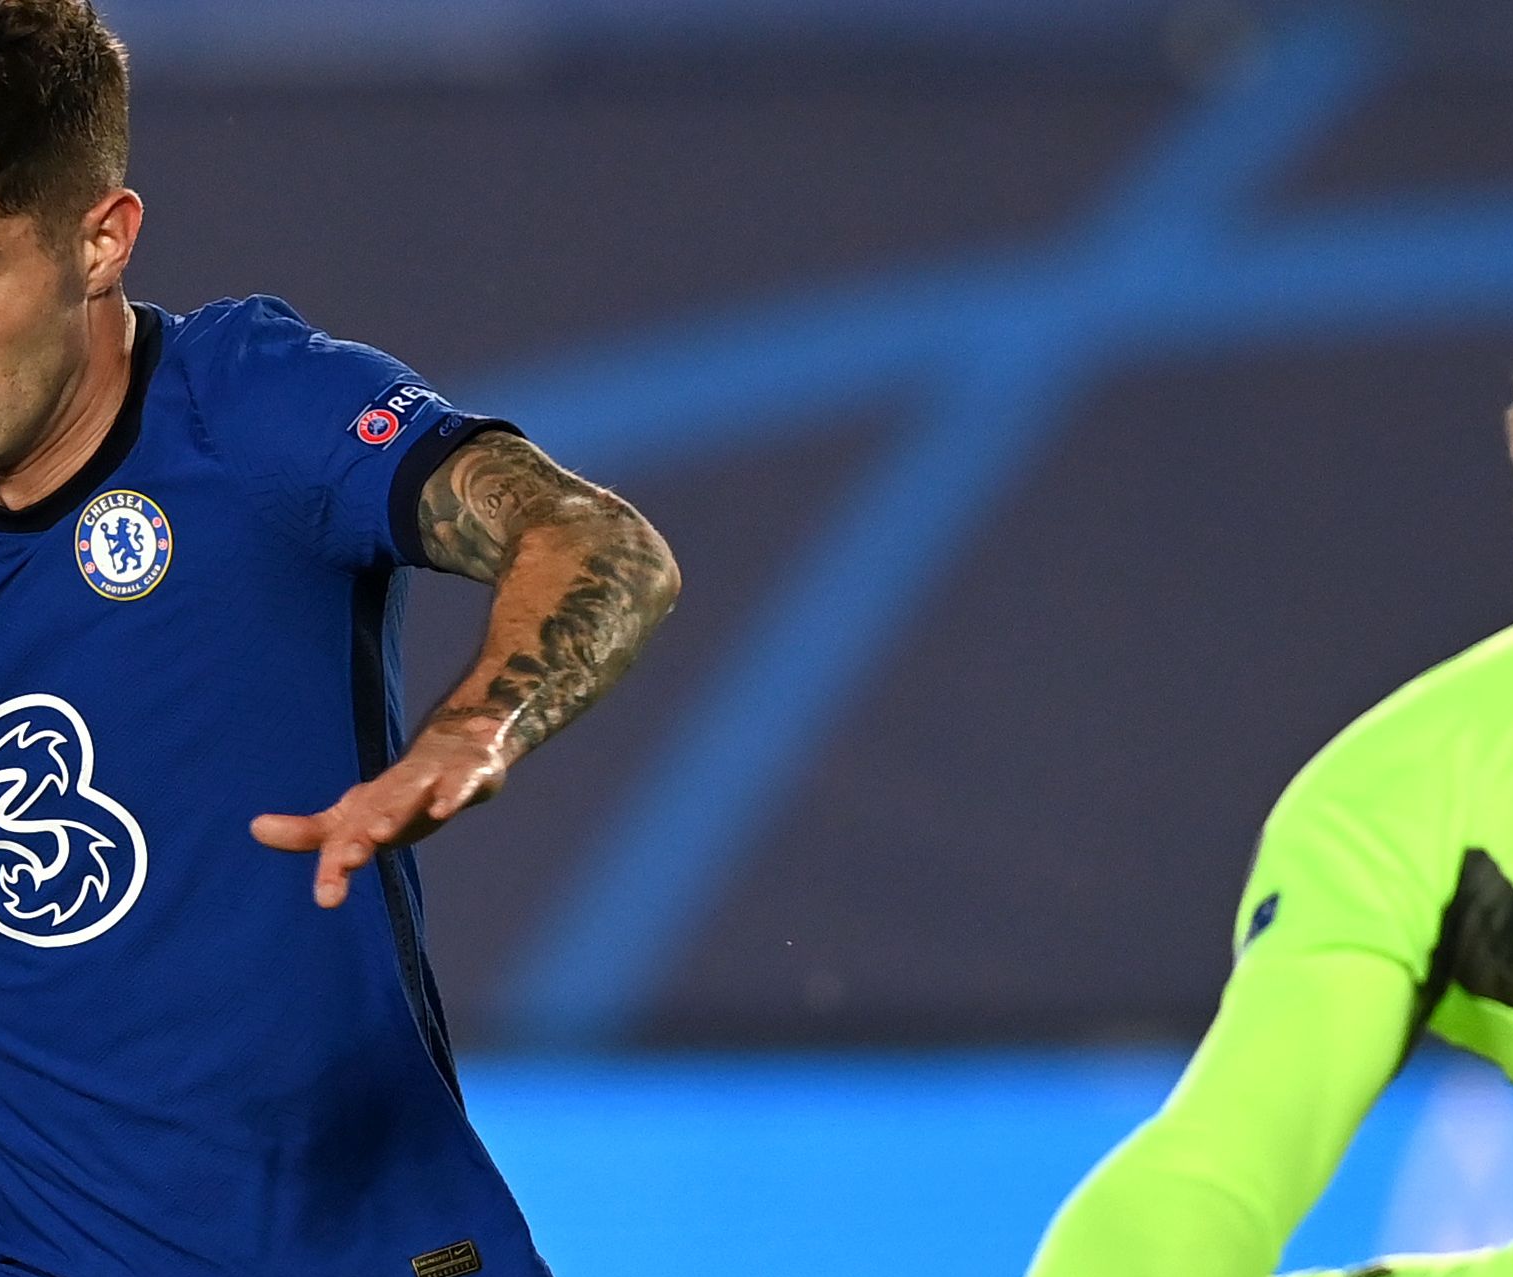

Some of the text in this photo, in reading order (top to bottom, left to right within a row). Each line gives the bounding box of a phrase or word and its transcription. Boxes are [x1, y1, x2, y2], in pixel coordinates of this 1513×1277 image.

[84, 494, 143, 526] CHELSEA
[100, 564, 162, 595] FOOTBALL CLUB
